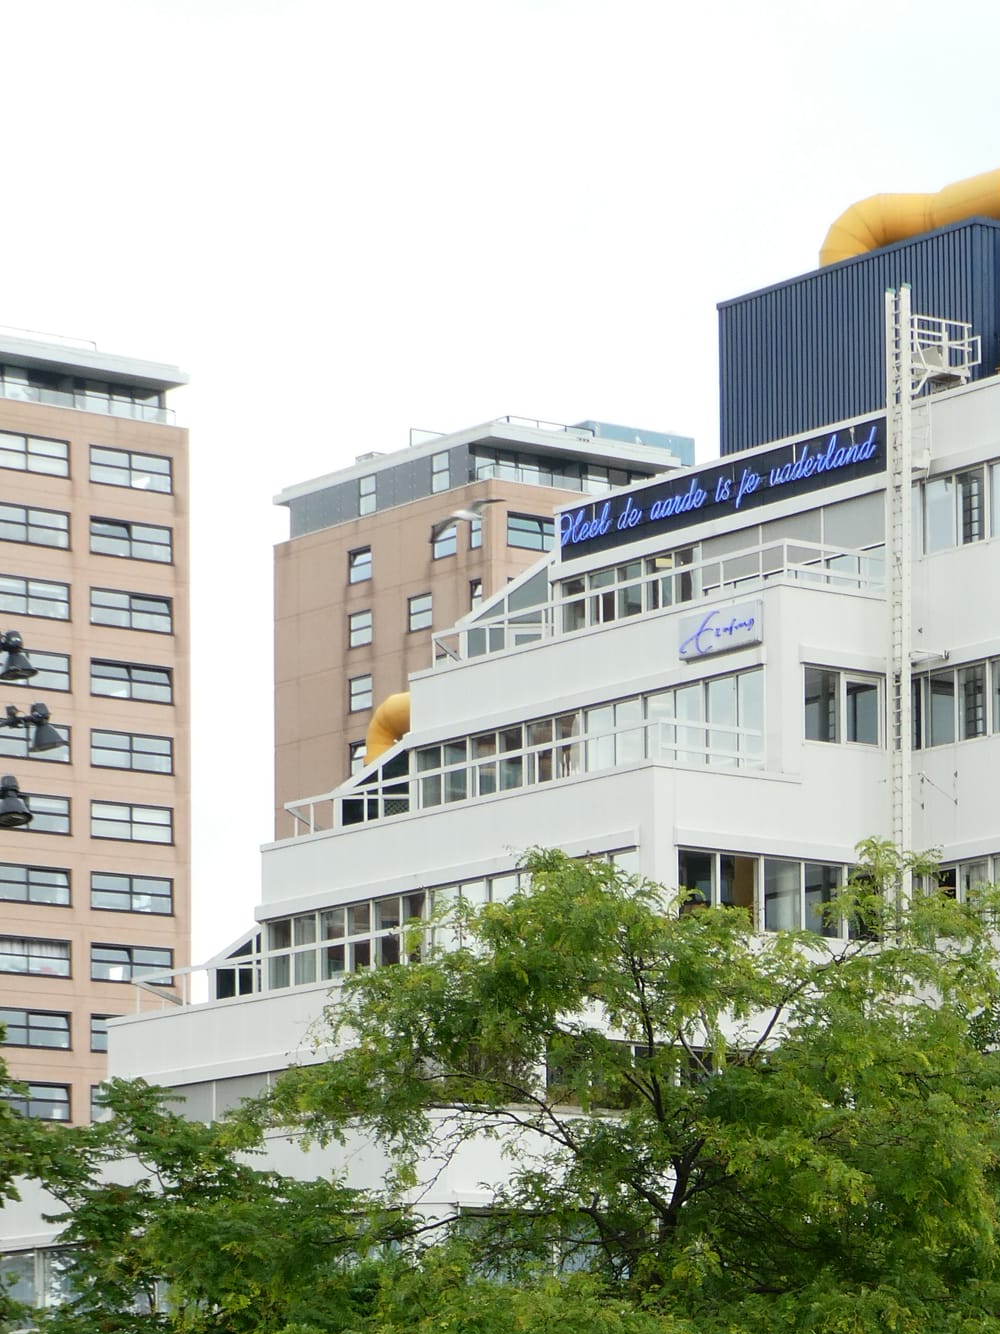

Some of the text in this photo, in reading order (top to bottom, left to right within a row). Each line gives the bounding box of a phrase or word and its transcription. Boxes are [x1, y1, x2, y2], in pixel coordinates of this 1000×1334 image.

[560, 426, 877, 548] Heel de aarde is je vaderland
